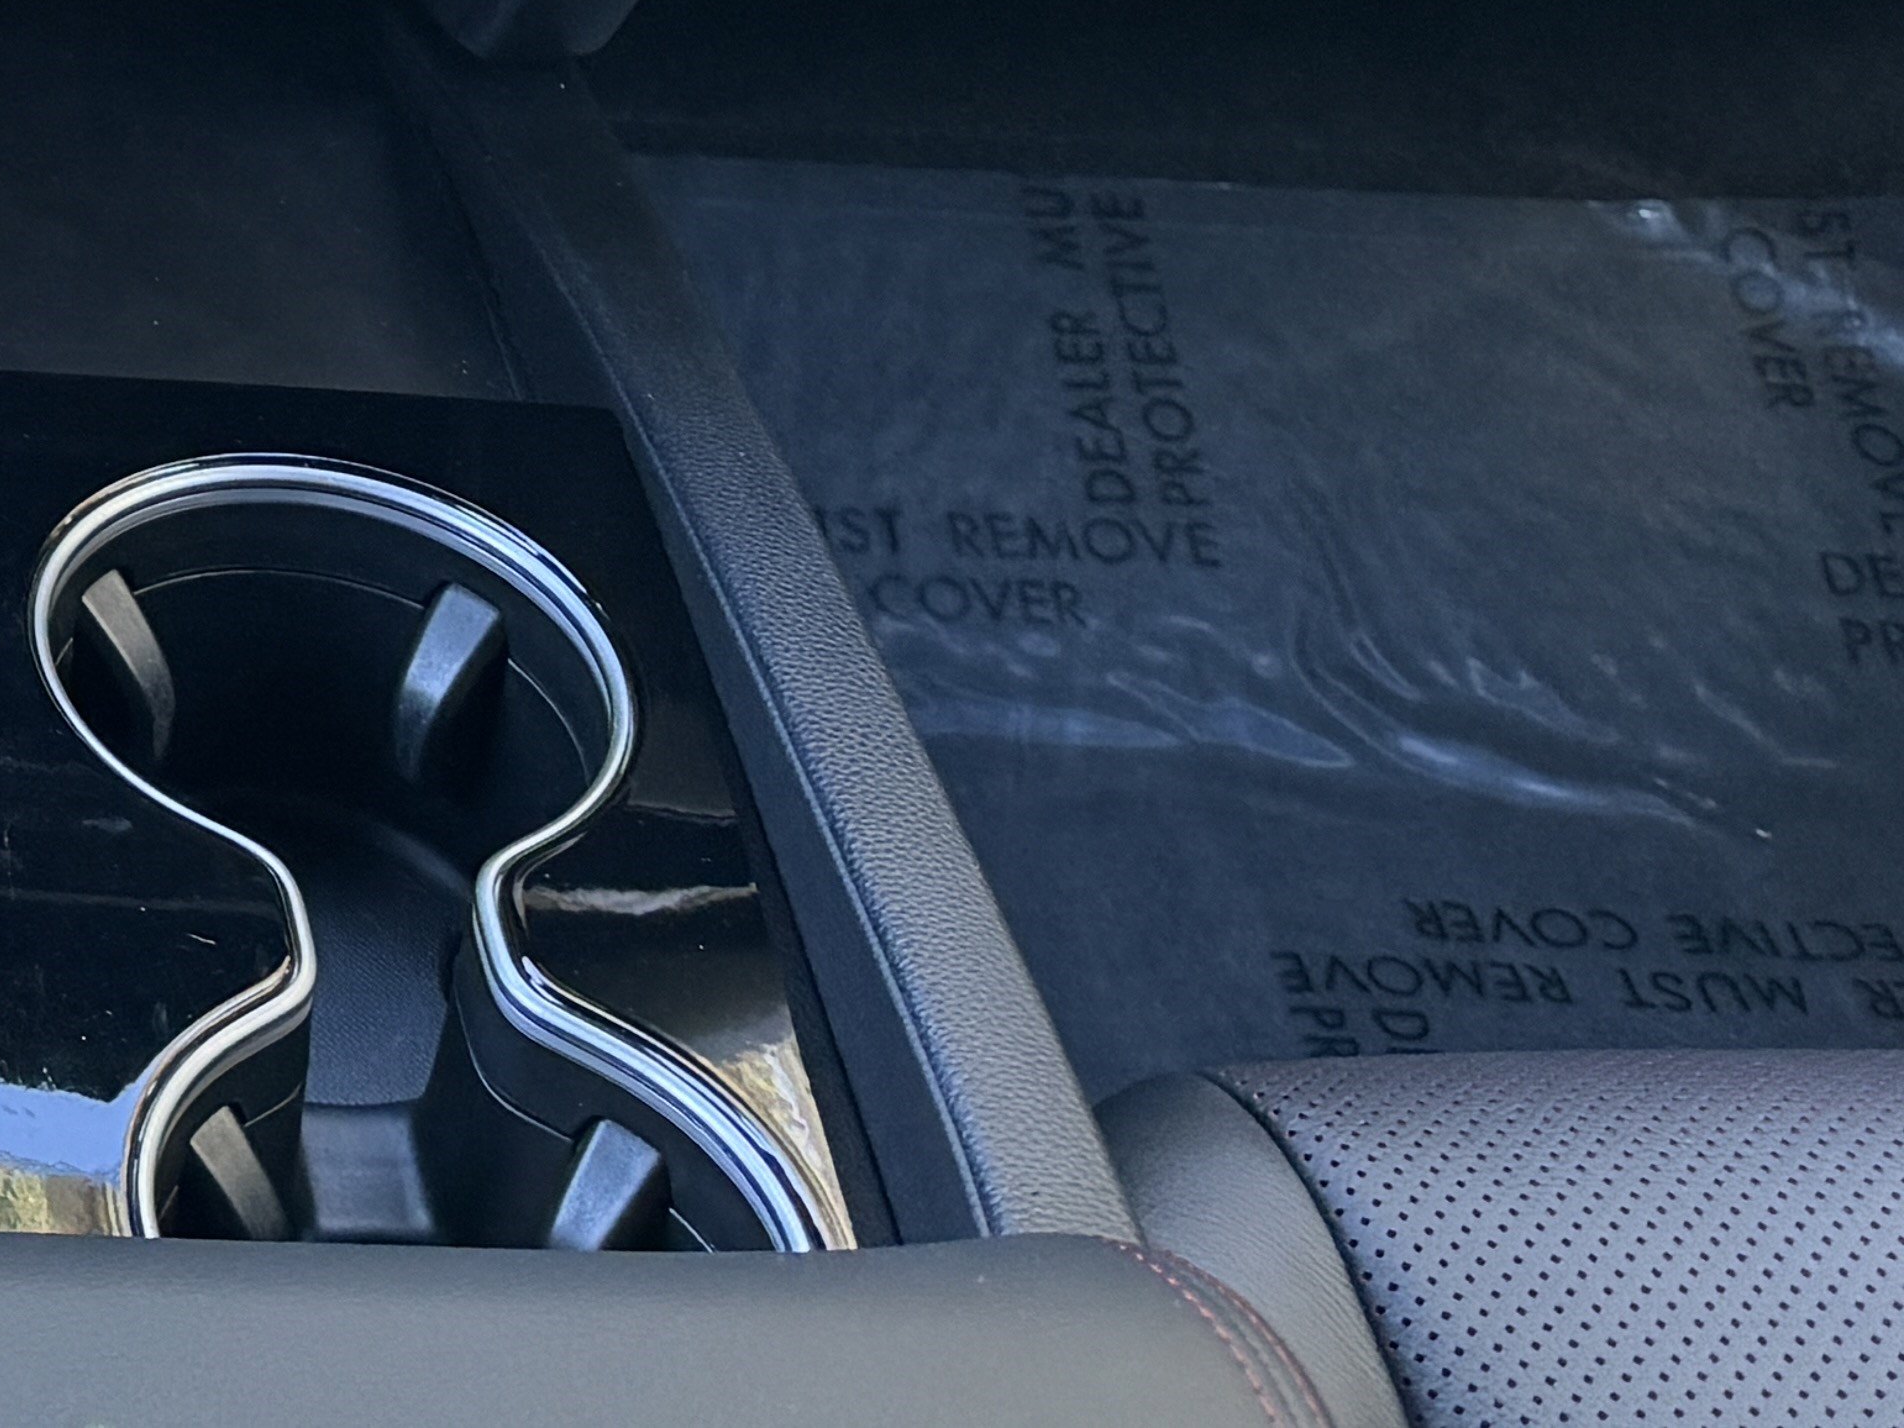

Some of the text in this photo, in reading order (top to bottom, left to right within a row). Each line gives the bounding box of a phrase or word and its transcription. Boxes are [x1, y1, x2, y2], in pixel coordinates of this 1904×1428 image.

[1089, 191, 1214, 508] PROTECTIVE
[1720, 223, 1817, 411] COVER
[1048, 310, 1136, 505] DEALER
[946, 510, 1222, 571] REMOVE
[868, 571, 1090, 629] COVER
[1399, 895, 1641, 952] COVER
[1268, 948, 1574, 1007] REMOVE
[1616, 966, 1812, 1018] MUST
